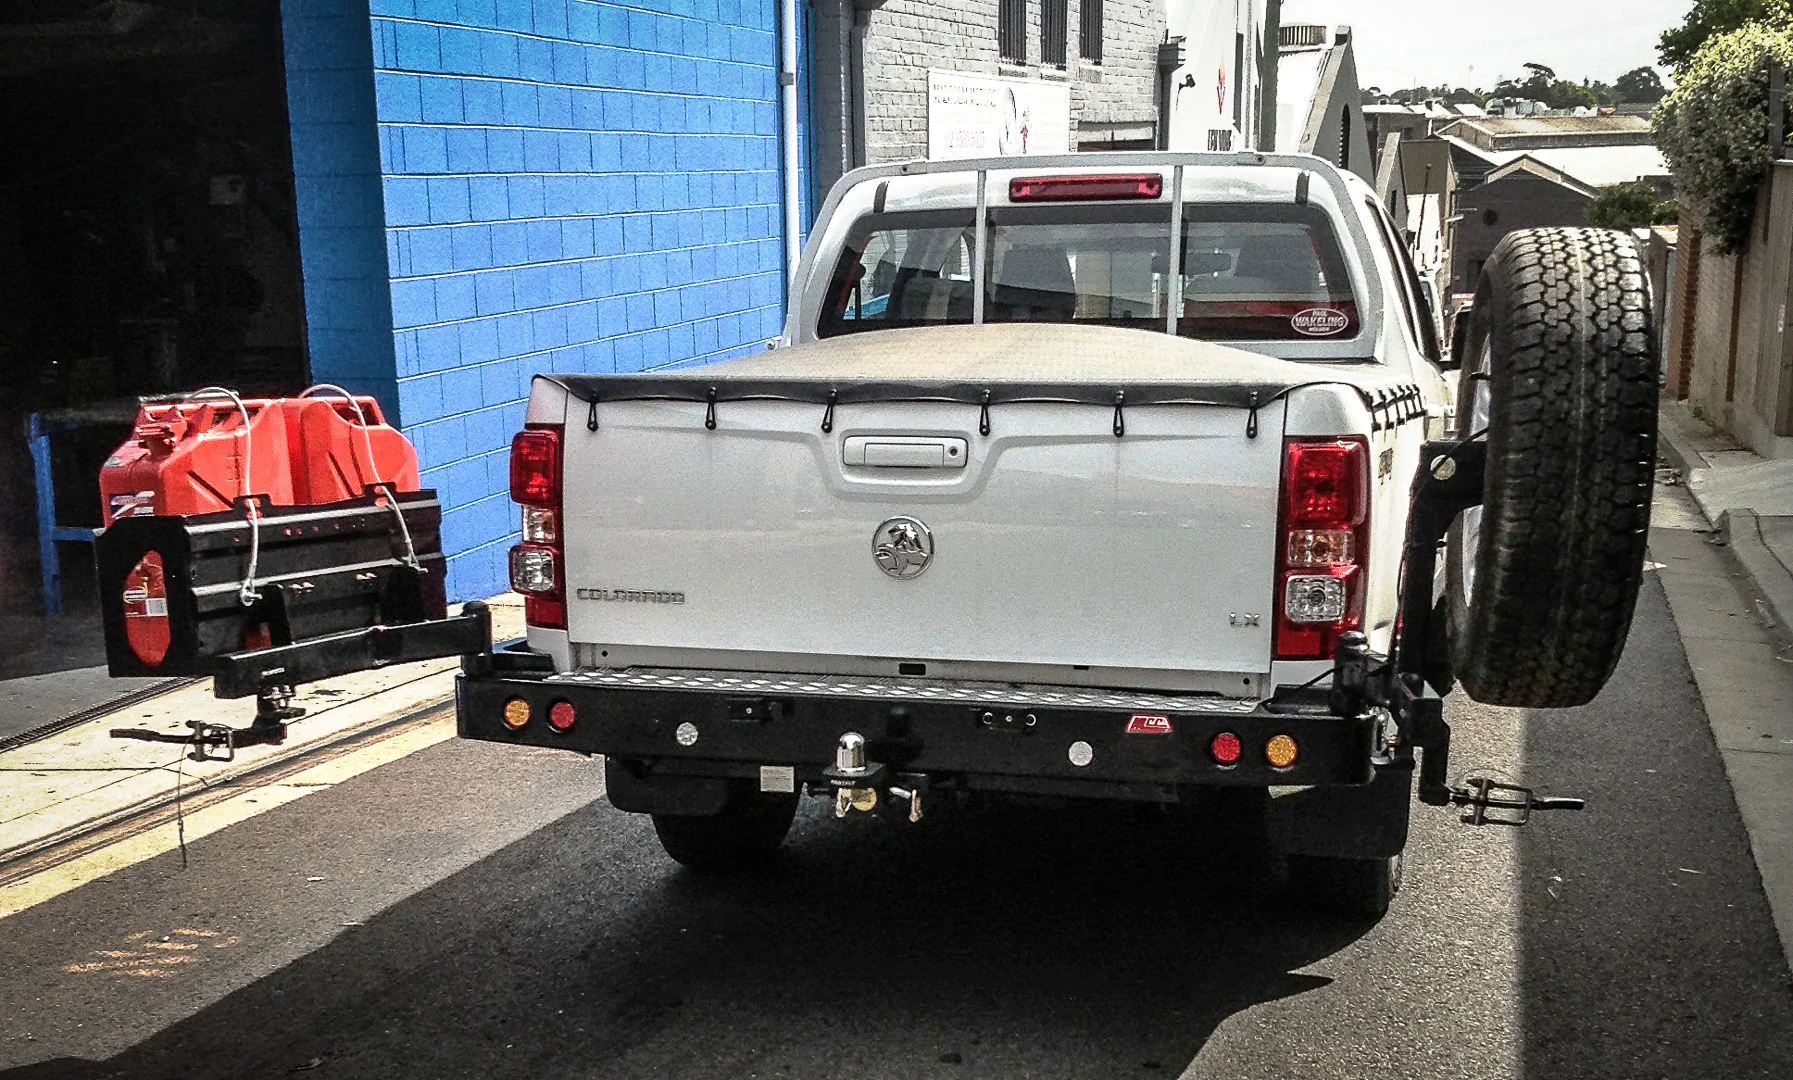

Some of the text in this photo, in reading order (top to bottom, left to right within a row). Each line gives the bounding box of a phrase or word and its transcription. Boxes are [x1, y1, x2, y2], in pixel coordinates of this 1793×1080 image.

[1295, 317, 1344, 327] WAKELING
[576, 588, 685, 604] COLORADO
[1229, 612, 1260, 628] LX
